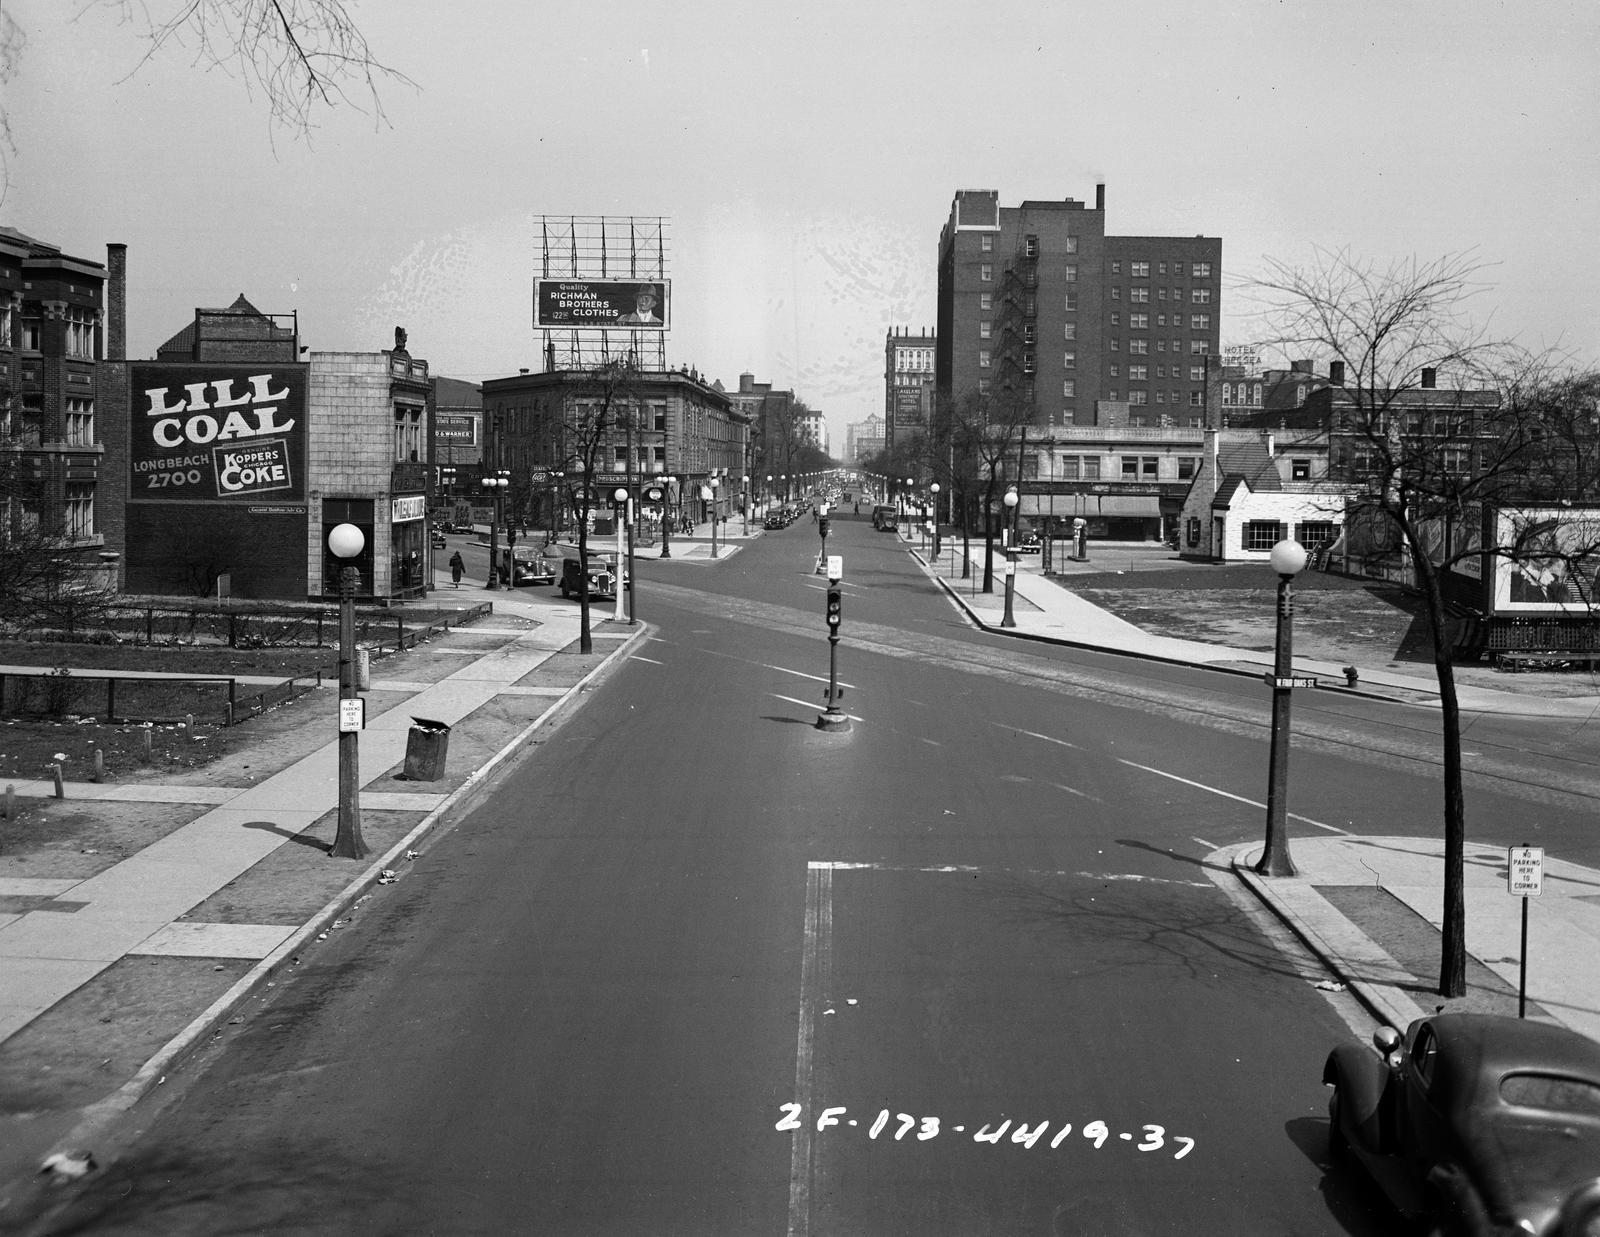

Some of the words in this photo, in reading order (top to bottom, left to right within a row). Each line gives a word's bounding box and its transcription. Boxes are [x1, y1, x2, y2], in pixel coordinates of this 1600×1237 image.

[559, 283, 589, 292] Quality
[559, 300, 609, 308] BROTHERS
[572, 308, 618, 316] CLOTHES
[1224, 346, 1255, 354] HOTEL
[145, 374, 290, 416] LILL
[152, 406, 296, 448] COAL
[224, 450, 279, 470] KOPPERS
[243, 460, 273, 469] CHICAGO
[147, 469, 201, 488] 2700
[220, 464, 286, 491] COKE
